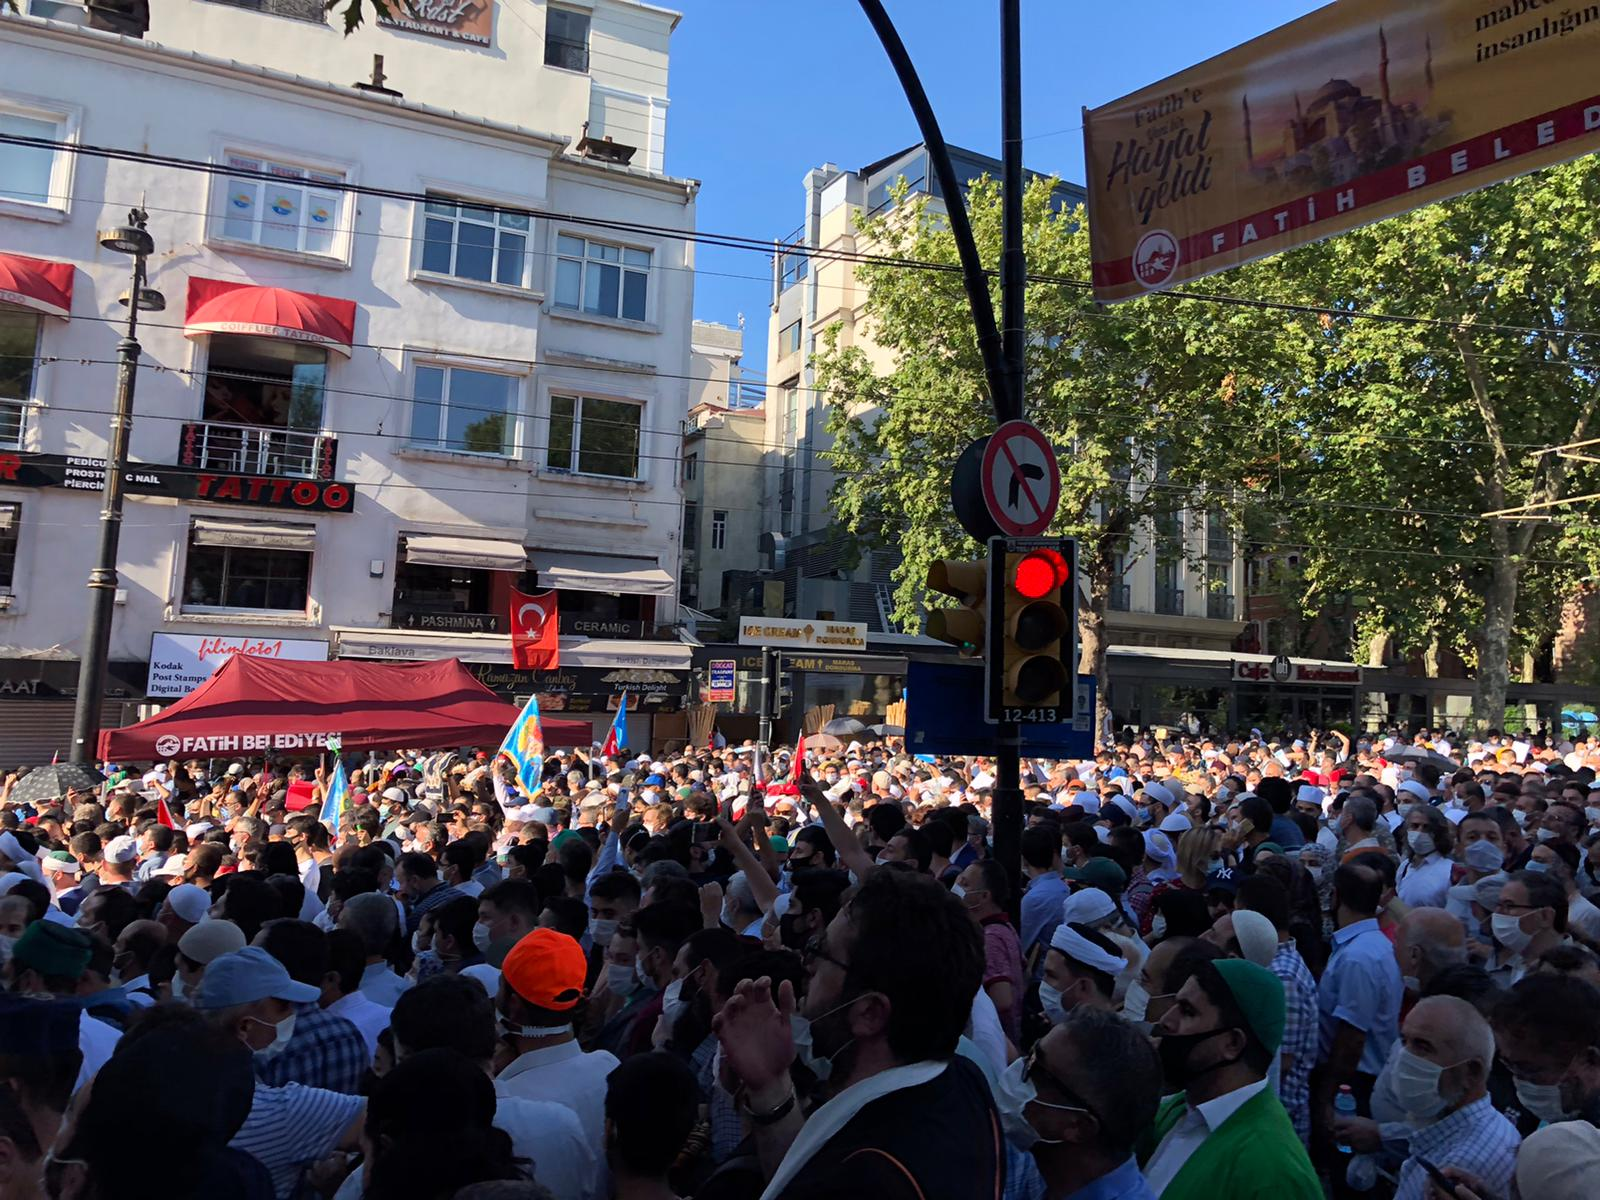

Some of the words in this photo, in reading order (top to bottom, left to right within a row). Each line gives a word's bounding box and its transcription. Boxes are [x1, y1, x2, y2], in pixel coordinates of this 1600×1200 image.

[1476, 0, 1556, 32] mabe
[1106, 110, 1213, 191] Hayal
[1137, 153, 1212, 225] geldi
[1211, 188, 1356, 253] FATİH
[196, 474, 350, 509] TATTOO
[743, 624, 762, 637] ICE
[368, 645, 416, 658] Baklava
[153, 661, 183, 671] Kodak
[152, 672, 173, 681] Post
[174, 673, 208, 684] Stamps
[151, 684, 182, 694] Digital
[615, 683, 641, 691] Turkish
[642, 684, 668, 694] Delight
[1004, 709, 1057, 723] 12-413
